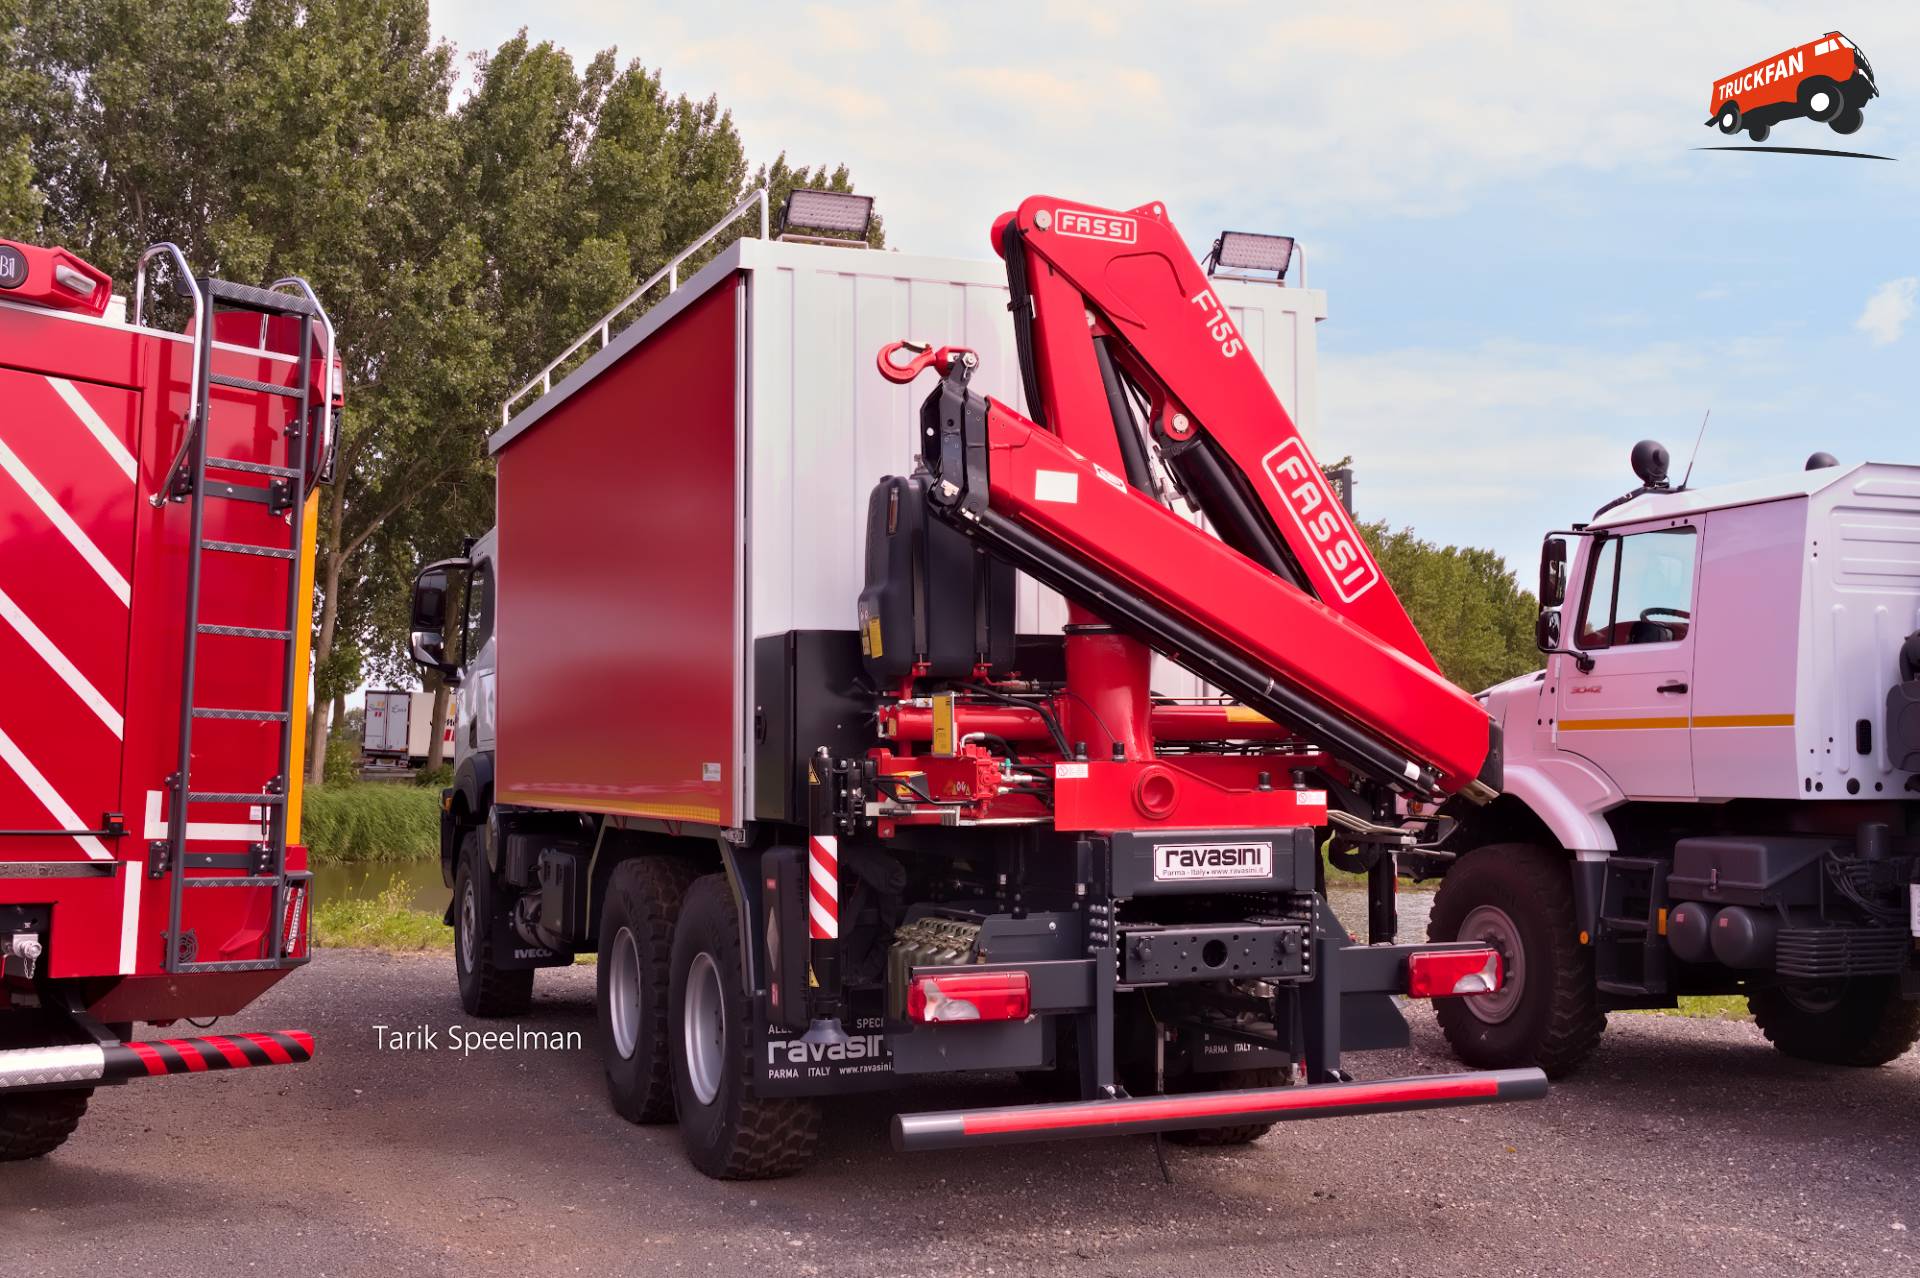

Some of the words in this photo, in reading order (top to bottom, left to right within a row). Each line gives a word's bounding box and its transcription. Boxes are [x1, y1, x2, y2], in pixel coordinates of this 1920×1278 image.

[1062, 215, 1130, 239] FASSI
[1191, 289, 1243, 358] F155
[1276, 455, 1365, 586] FASSI
[1165, 848, 1261, 868] ravasini
[1162, 869, 1186, 877] Parma
[856, 1018, 884, 1029] SPECI
[1204, 1045, 1228, 1054] PARMA
[1234, 1043, 1251, 1052] ITALY
[768, 1069, 799, 1079] PARMA
[808, 1066, 831, 1077] ITALY
[839, 1062, 894, 1075] www.ravasini.
